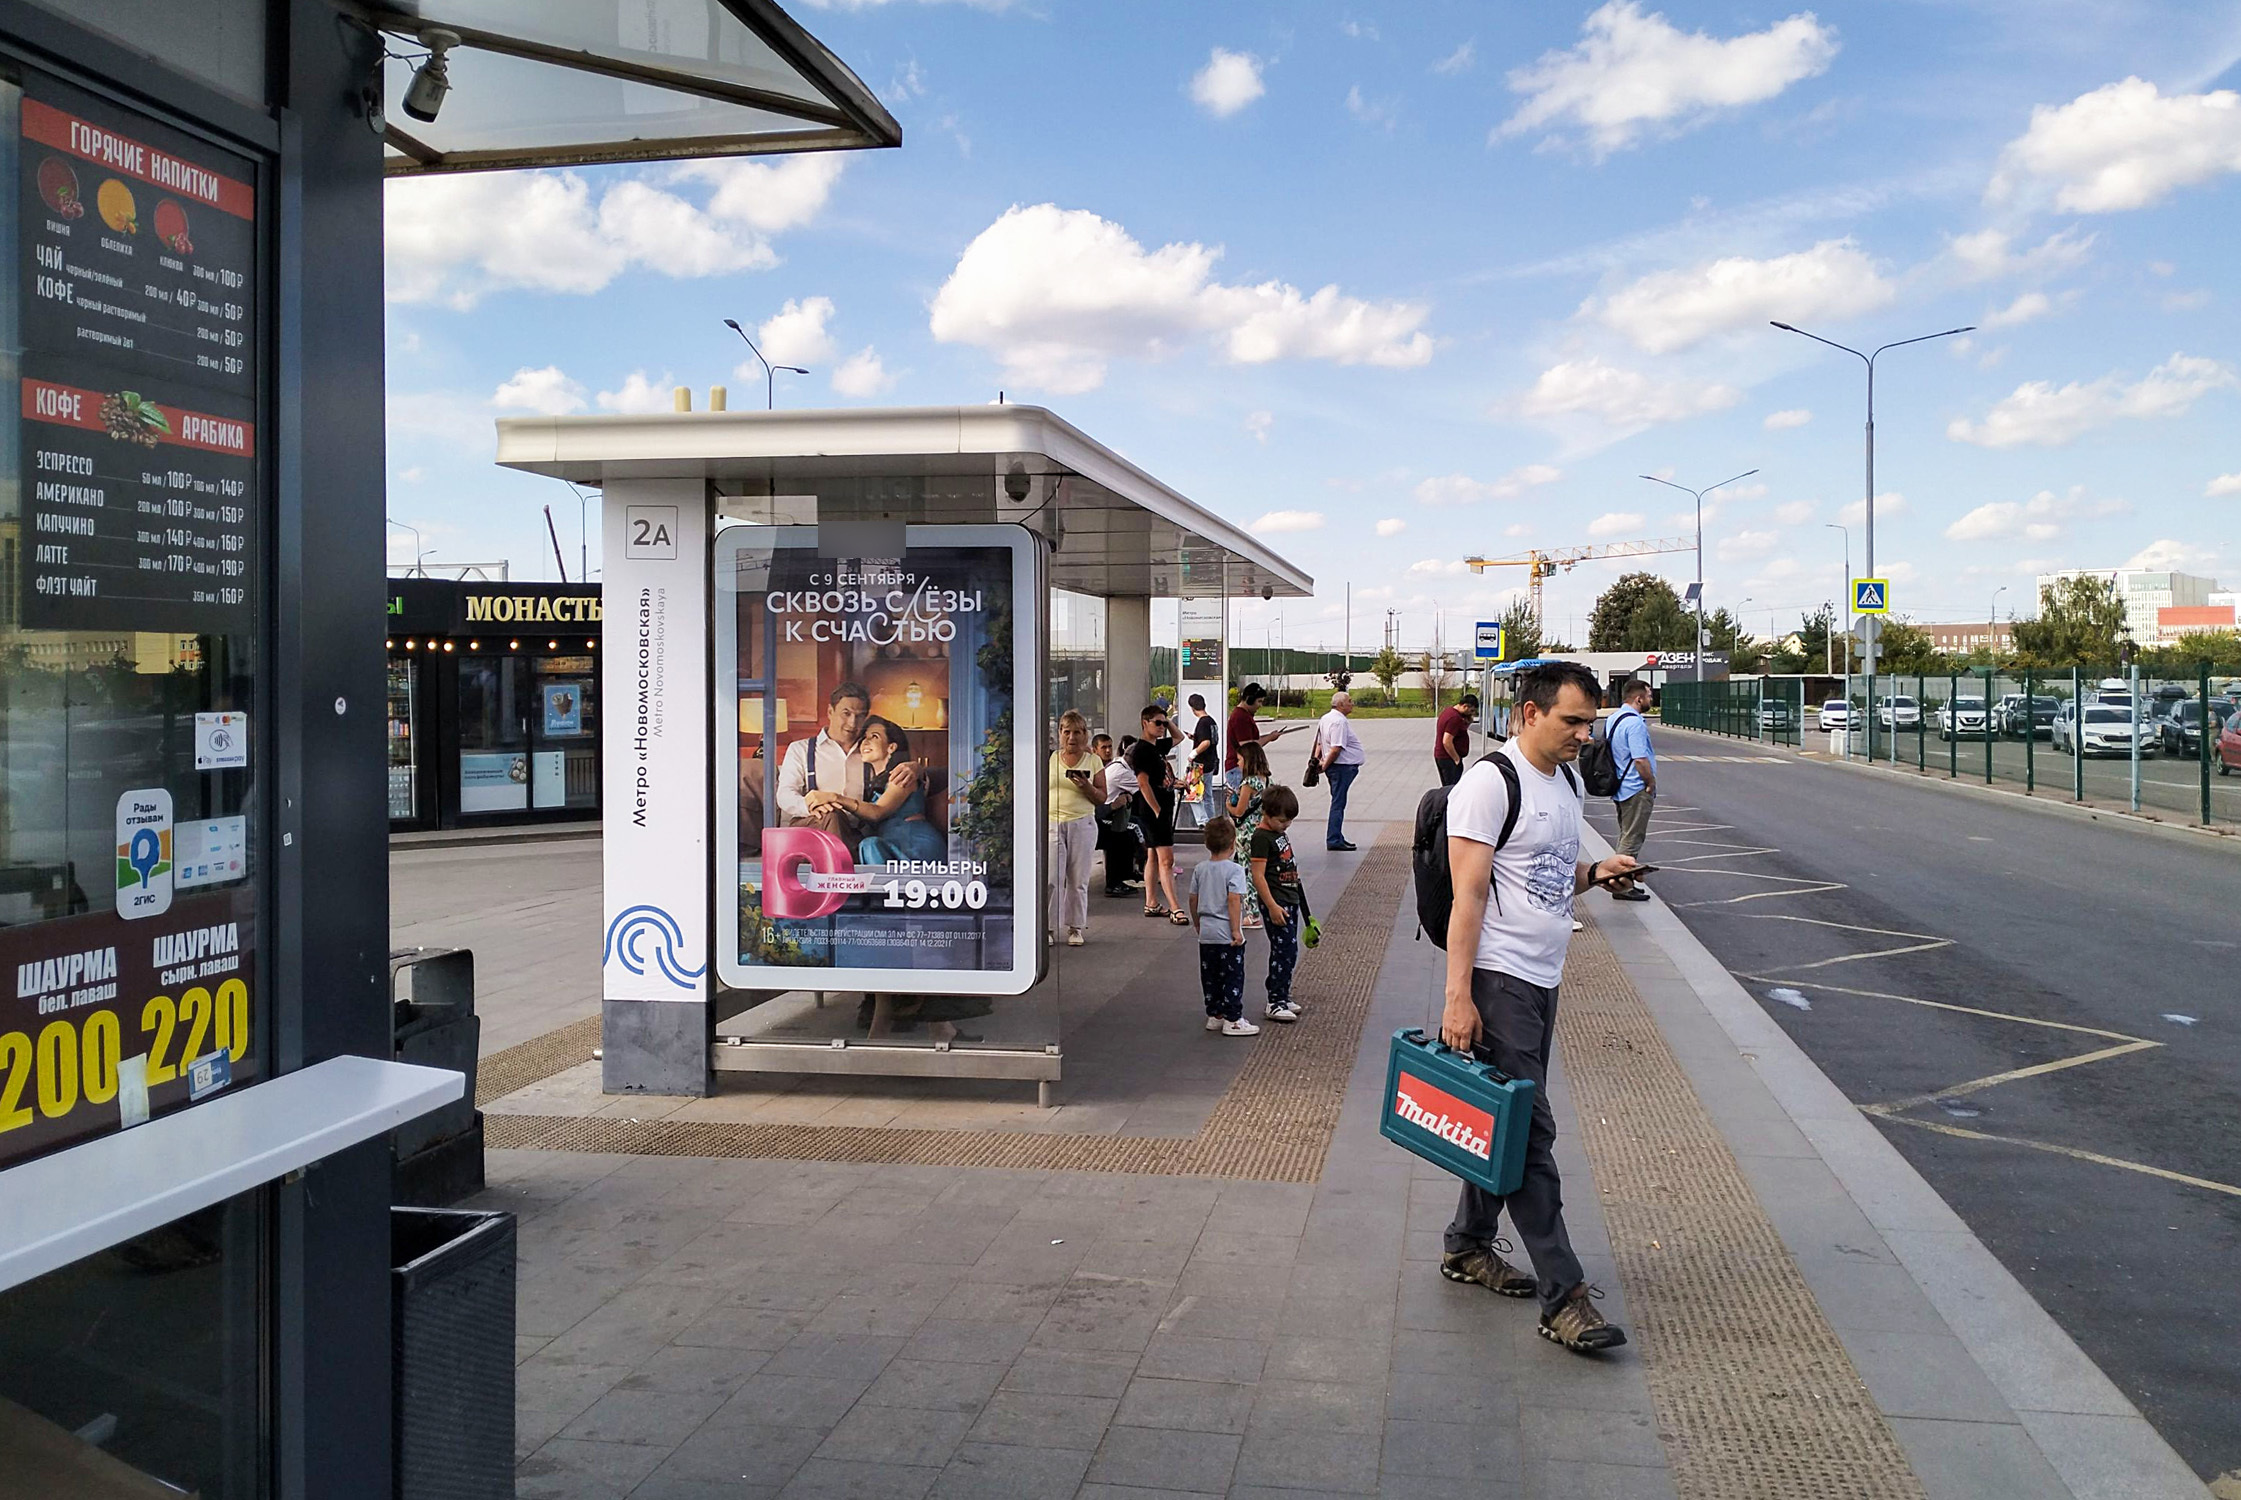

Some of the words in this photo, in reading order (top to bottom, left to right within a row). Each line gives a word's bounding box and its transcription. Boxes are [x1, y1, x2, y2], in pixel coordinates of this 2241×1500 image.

[71, 121, 144, 175] ГОРЯЧИЕ
[151, 152, 218, 202] НАПИТКИ
[36, 243, 63, 271] ЧАЙ
[101, 237, 133, 256] ОБЛЕПИХА
[37, 274, 74, 304] КОФЕ
[36, 387, 82, 421] КОФЕ
[182, 415, 244, 450] АРАБИКА
[36, 450, 93, 476] ЭСПРЕССО
[36, 481, 104, 508] АМЕРИКАНО
[36, 513, 95, 536] КАПУЧИНО
[35, 544, 69, 565] ЛАТТЕ
[36, 574, 68, 595] ФЛЭТ
[809, 574, 819, 586] С
[824, 574, 832, 586] 9
[837, 573, 915, 586] СЕНТЯБРЯ
[766, 591, 878, 614] СКВОЗЬ
[885, 576, 982, 623] СЛЁЗЫ
[654, 588, 668, 697] Novomoskovskaya
[785, 620, 804, 642] К
[811, 611, 957, 645] СЧАСТЬЮ
[634, 588, 650, 761] «Новомосковская»
[653, 700, 664, 738] Metro
[133, 803, 157, 813] Рады
[633, 766, 650, 827] Метро
[126, 814, 164, 825] отзывам
[886, 859, 988, 875] ПРЕМЬЕРЫ
[133, 894, 156, 906] 2ГИС
[817, 882, 865, 890] ЖЕНСКИЙ
[882, 879, 988, 909] 19:00
[153, 922, 239, 968] ШАУРМА
[761, 926, 781, 945] 16+
[17, 946, 117, 998] ШАУРМА
[161, 965, 197, 986] сырн.
[199, 954, 239, 978] лаваш
[38, 995, 69, 1015] бел.
[70, 982, 117, 1007] лаваш
[141, 978, 248, 1087] 220
[0, 1009, 121, 1134] 200
[1397, 1090, 1490, 1161] makita
